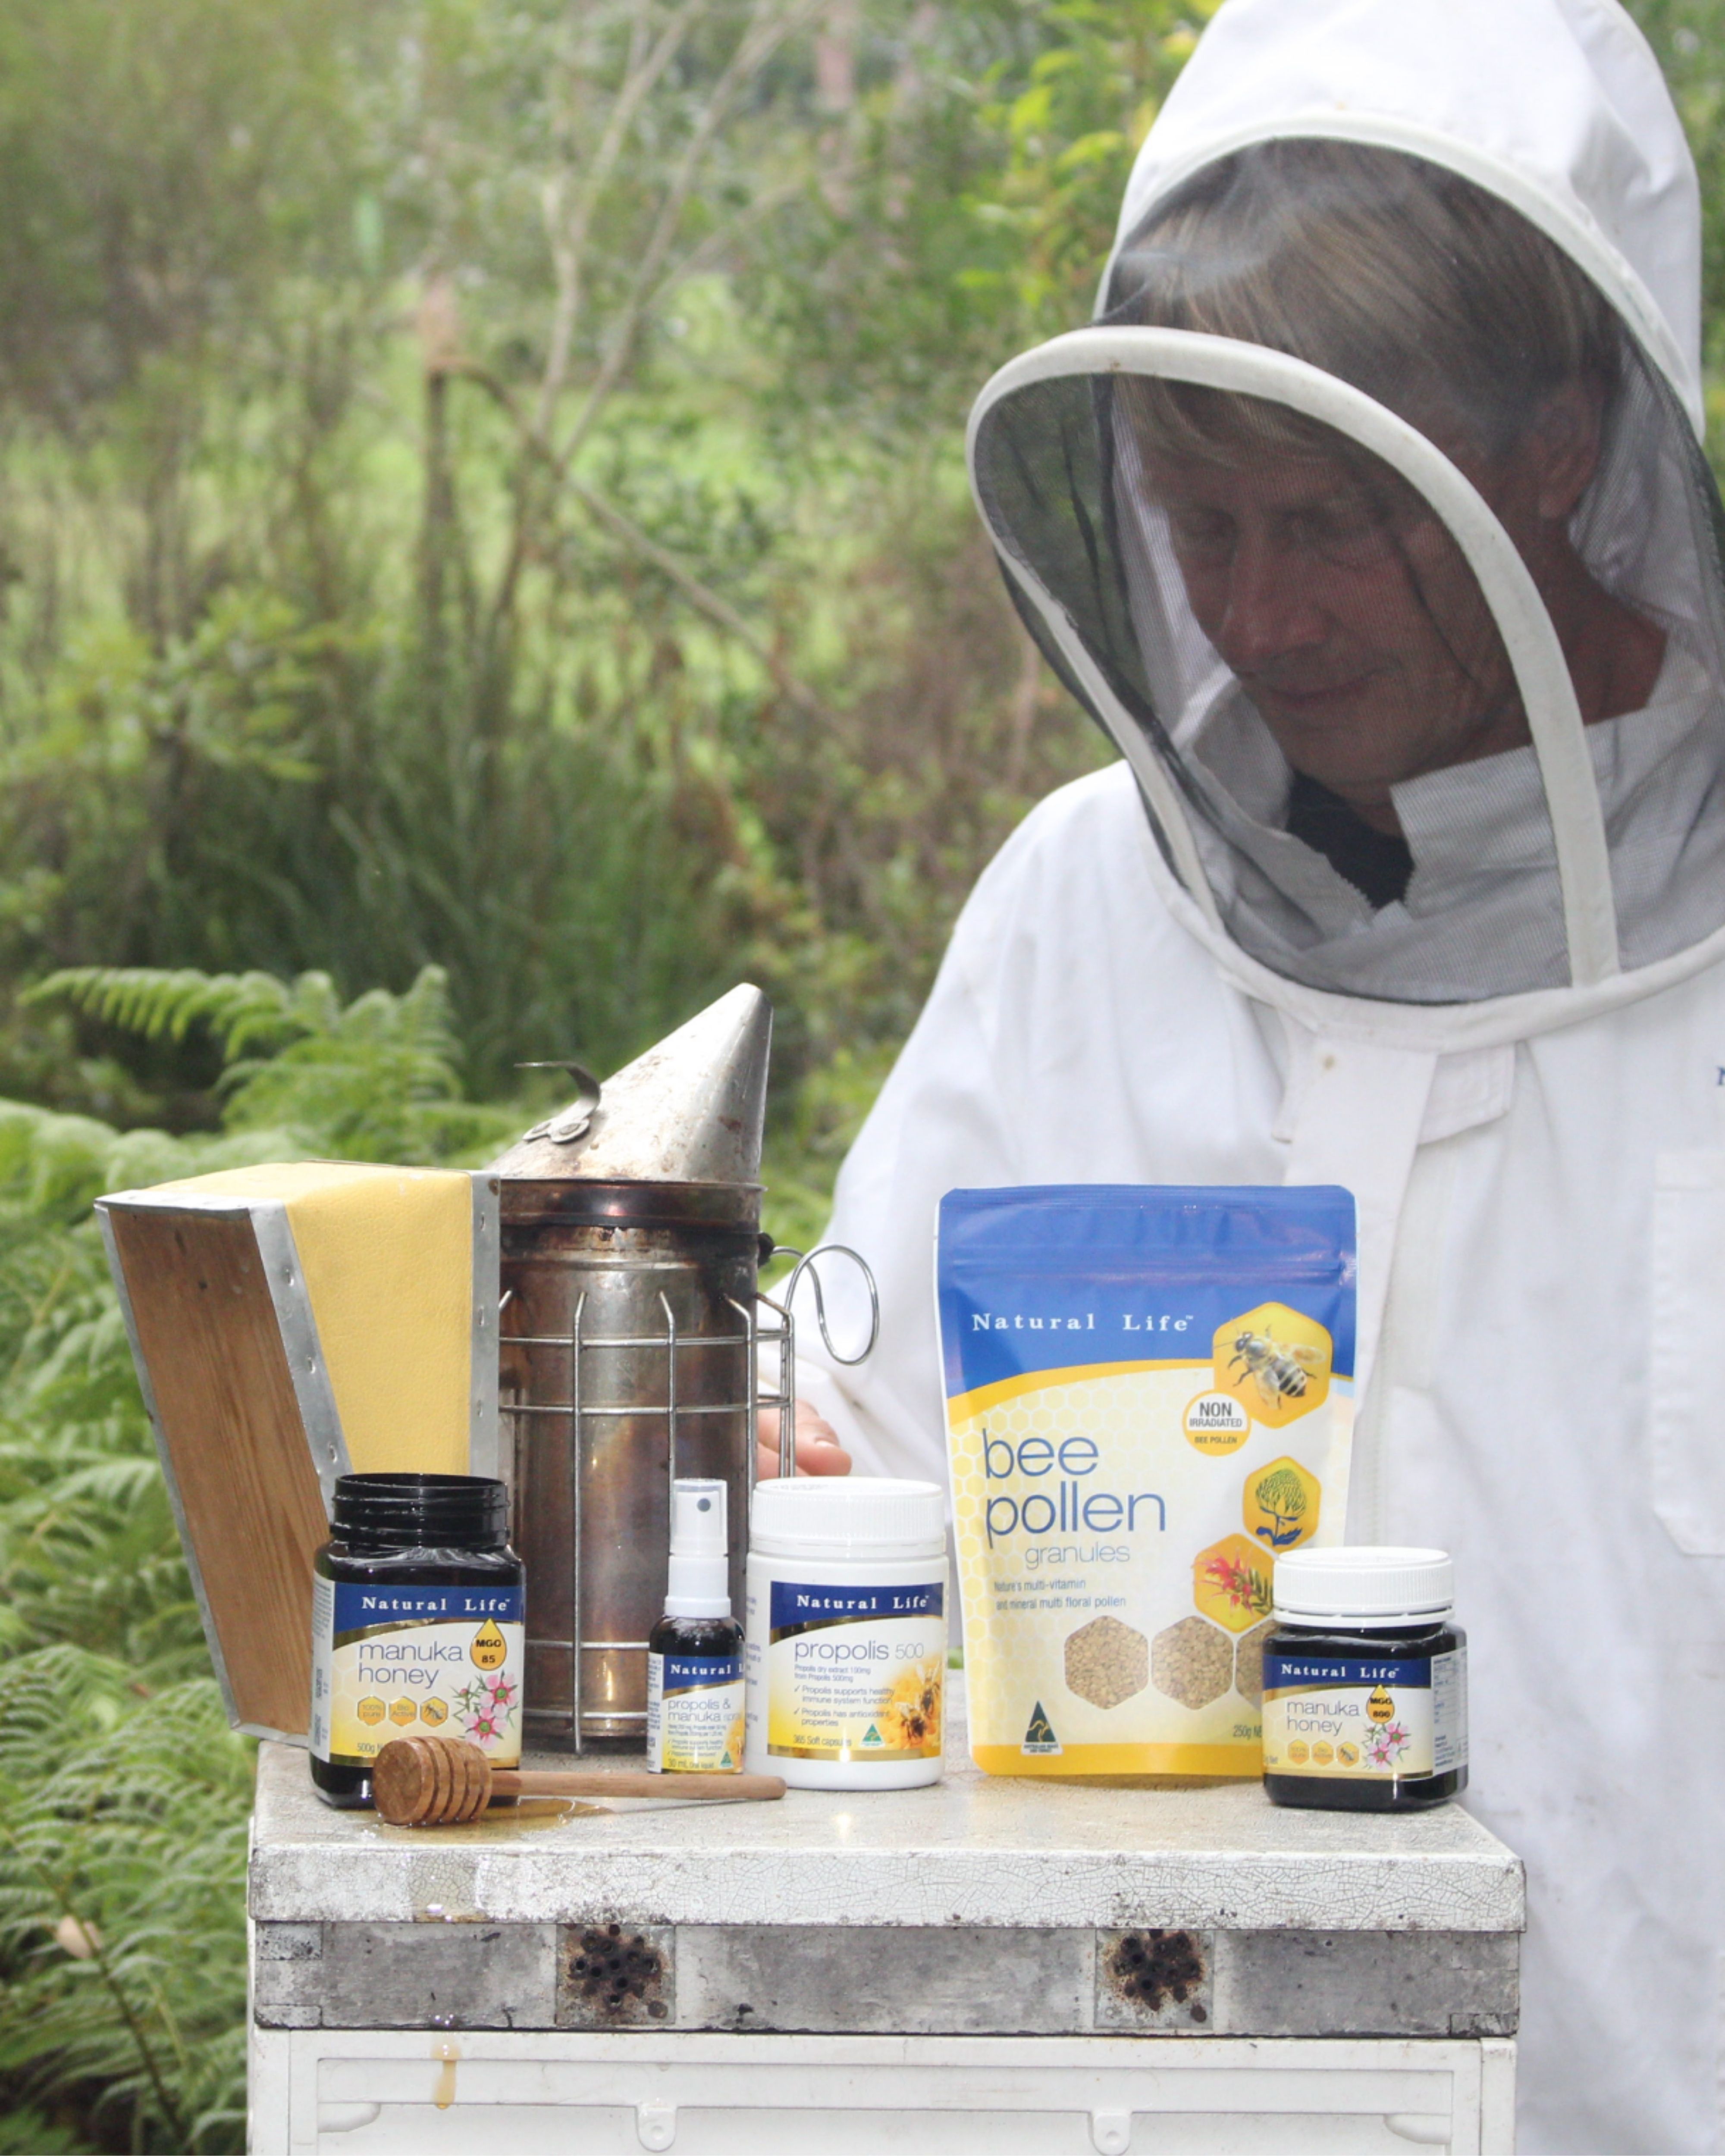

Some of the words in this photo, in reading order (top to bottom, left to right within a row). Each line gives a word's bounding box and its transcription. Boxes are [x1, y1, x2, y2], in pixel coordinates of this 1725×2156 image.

[972, 1313, 1095, 1331] Natural
[1199, 1402, 1232, 1417] NON
[1189, 1417, 1242, 1427] IRRADIATED
[982, 1428, 1098, 1479] bee
[986, 1481, 1165, 1549] pollen
[1025, 1542, 1130, 1570] granules
[1024, 1579, 1086, 1591] multi-vitamin
[361, 1596, 447, 1611] Natural
[797, 1595, 877, 1609] Natural
[1039, 1597, 1063, 1608] multi
[1065, 1596, 1091, 1608] floral
[1095, 1595, 1126, 1608] pollen
[476, 1639, 502, 1648] MGO
[359, 1641, 463, 1661] manuka
[795, 1640, 889, 1664] propolis
[895, 1642, 924, 1660] 500
[481, 1655, 496, 1663] 85
[358, 1662, 439, 1689] honey
[671, 1664, 731, 1675] Natural
[1281, 1664, 1346, 1677] Natural
[802, 1685, 832, 1694] Propolis
[834, 1687, 867, 1695] supports
[869, 1688, 895, 1697] healthy
[668, 1698, 720, 1712] propolis
[801, 1707, 831, 1717] Propolis
[1286, 1700, 1360, 1717] manuka
[668, 1711, 721, 1722] manuka
[1287, 1717, 1342, 1736] honey
